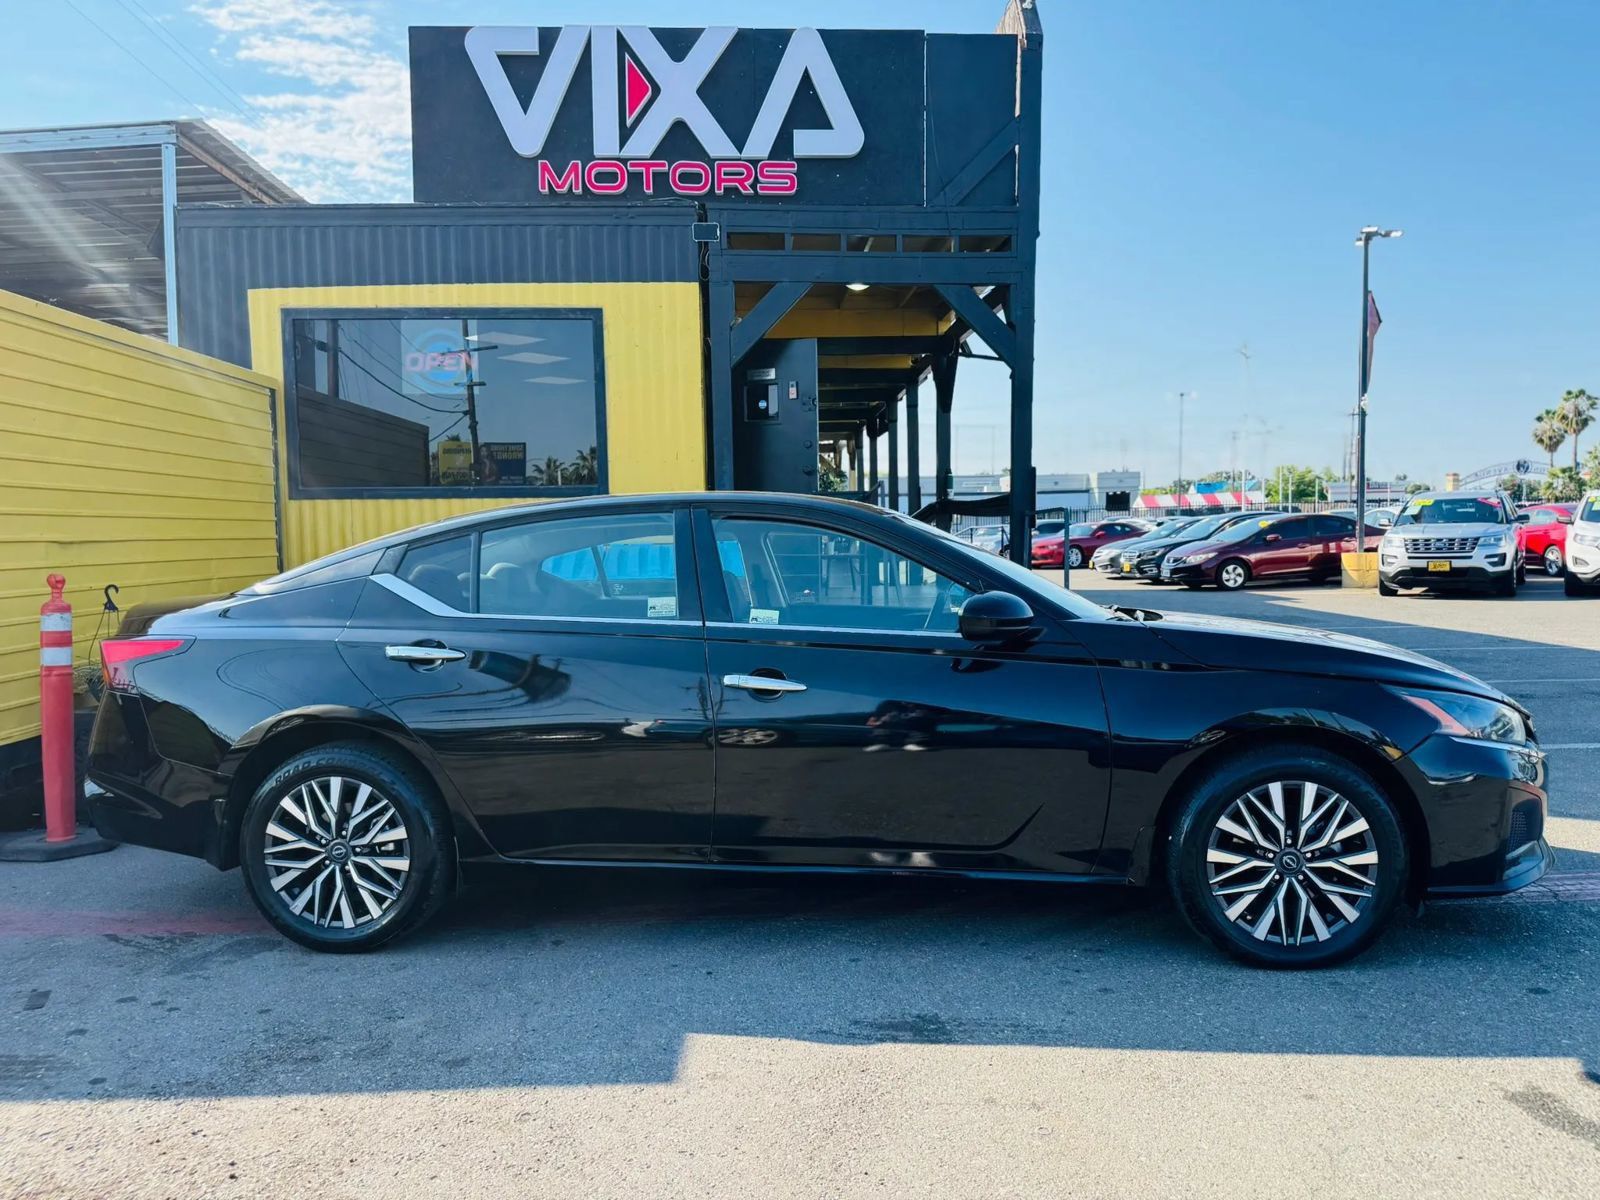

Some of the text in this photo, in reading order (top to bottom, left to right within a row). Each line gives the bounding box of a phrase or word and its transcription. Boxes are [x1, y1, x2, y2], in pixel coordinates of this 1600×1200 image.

[464, 25, 865, 160] VIXA
[538, 159, 798, 196] MOTORS
[405, 351, 478, 372] OPEN
